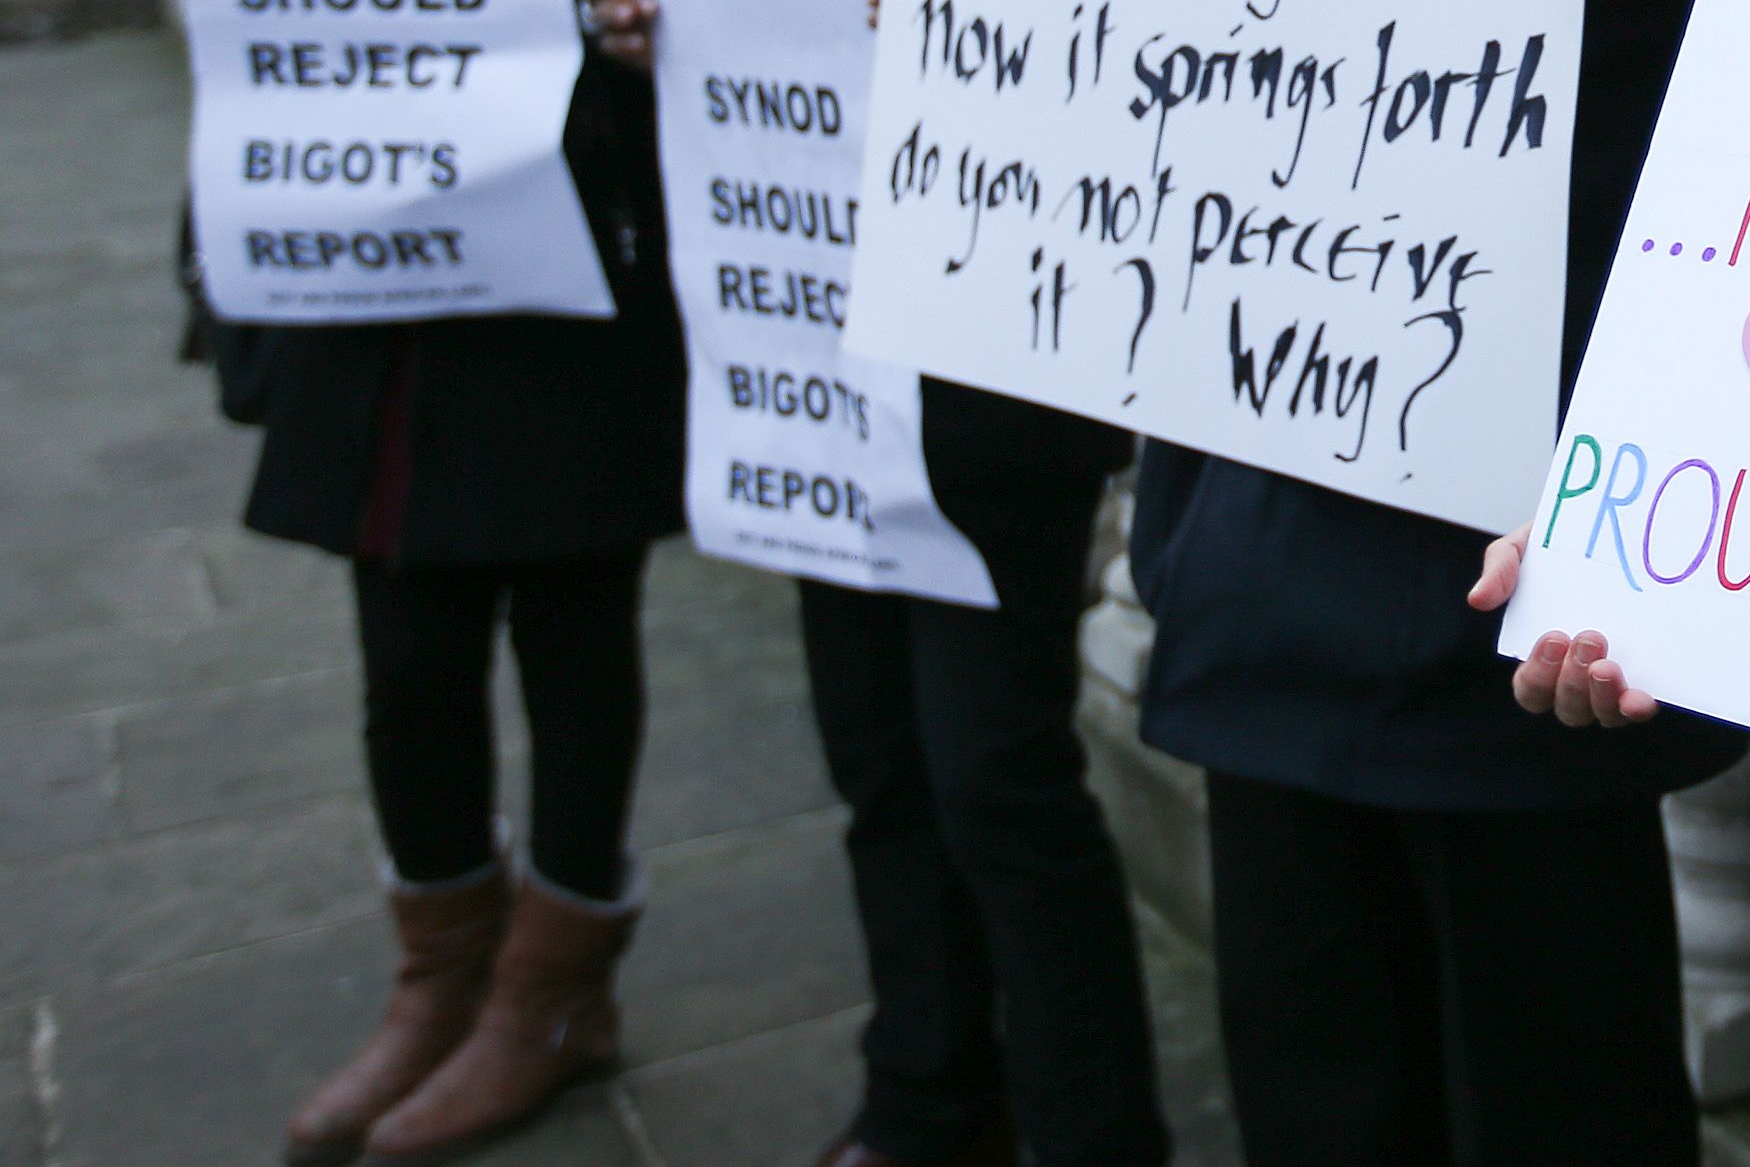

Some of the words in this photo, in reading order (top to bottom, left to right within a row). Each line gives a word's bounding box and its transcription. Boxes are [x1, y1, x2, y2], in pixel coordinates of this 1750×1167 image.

[249, 42, 482, 88] REJECT
[1065, 0, 1117, 102] it
[1129, 24, 1348, 188] springs
[1352, 20, 1548, 190] forth
[706, 76, 841, 135] SYNOD
[243, 139, 458, 188] BIGOT'S
[890, 121, 940, 207] do
[945, 142, 1042, 274] you
[1053, 166, 1174, 246] not
[1182, 190, 1494, 313] perceive
[245, 229, 465, 270] REPORT
[718, 262, 847, 330] REJEC
[728, 459, 875, 533] REPOR
